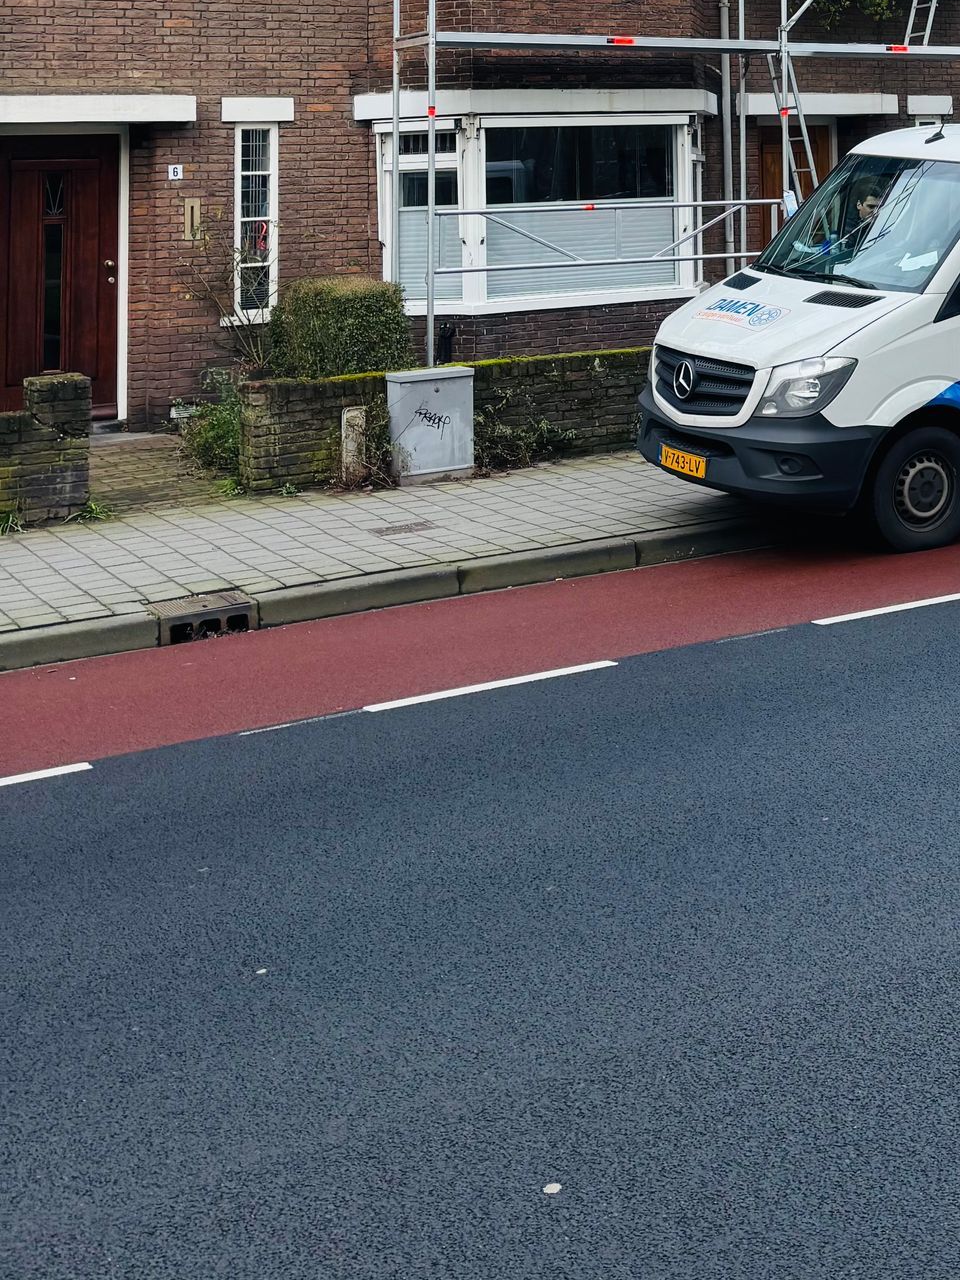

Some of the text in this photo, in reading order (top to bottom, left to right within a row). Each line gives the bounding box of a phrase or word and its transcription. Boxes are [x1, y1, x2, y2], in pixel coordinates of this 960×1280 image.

[172, 166, 179, 177] 6
[705, 298, 767, 317] DAMEN
[664, 449, 701, 474] V-743-LV
